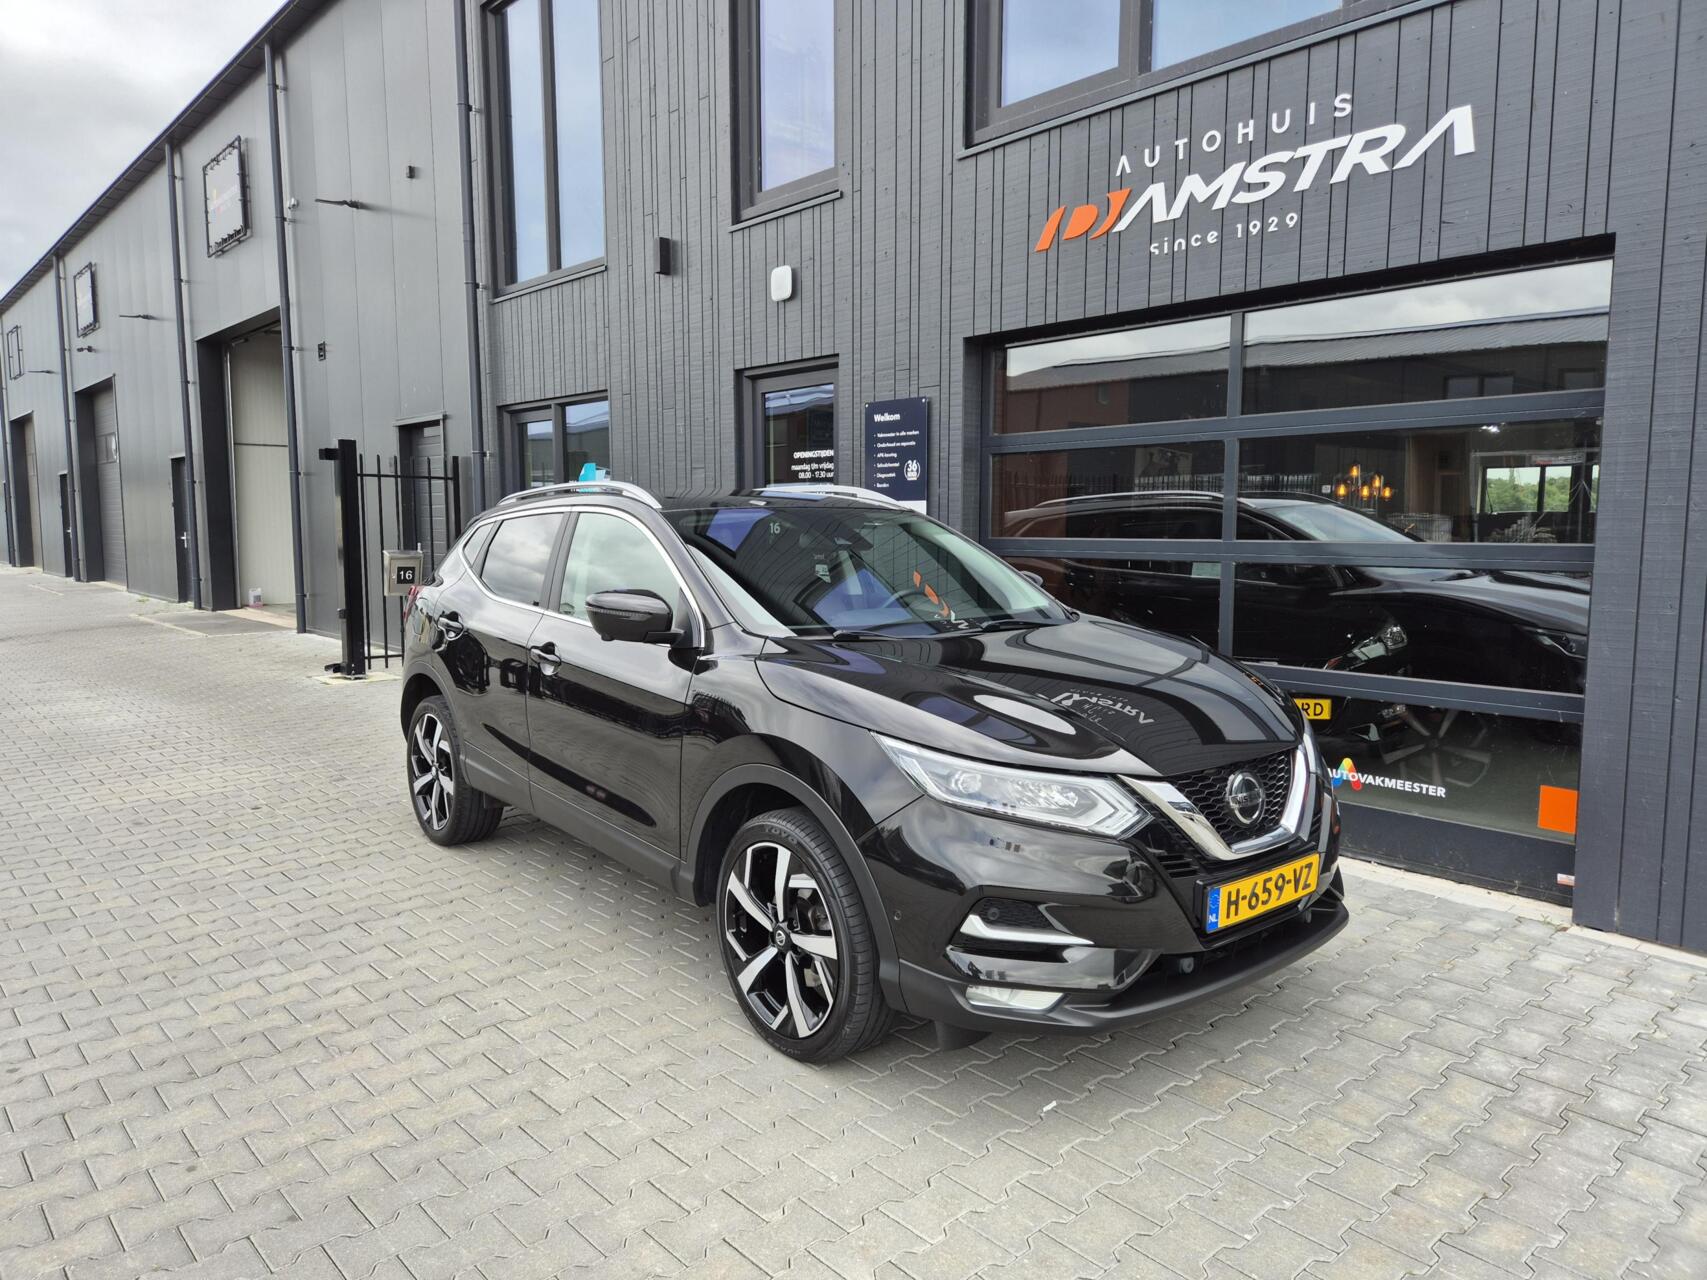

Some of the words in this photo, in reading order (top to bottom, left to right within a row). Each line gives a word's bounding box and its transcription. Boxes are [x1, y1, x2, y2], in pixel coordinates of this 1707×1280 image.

[1115, 93, 1352, 177] AUTOHUIS
[1149, 230, 1218, 255] since
[1235, 212, 1298, 238] 1929
[874, 412, 900, 422] Welkom
[793, 450, 834, 459] OPENINGSTIJDEN
[907, 459, 918, 471] 36
[770, 522, 780, 534] 16
[399, 570, 413, 580] 16
[1226, 862, 1313, 919] H-659-VZ
[1208, 913, 1218, 924] NL
